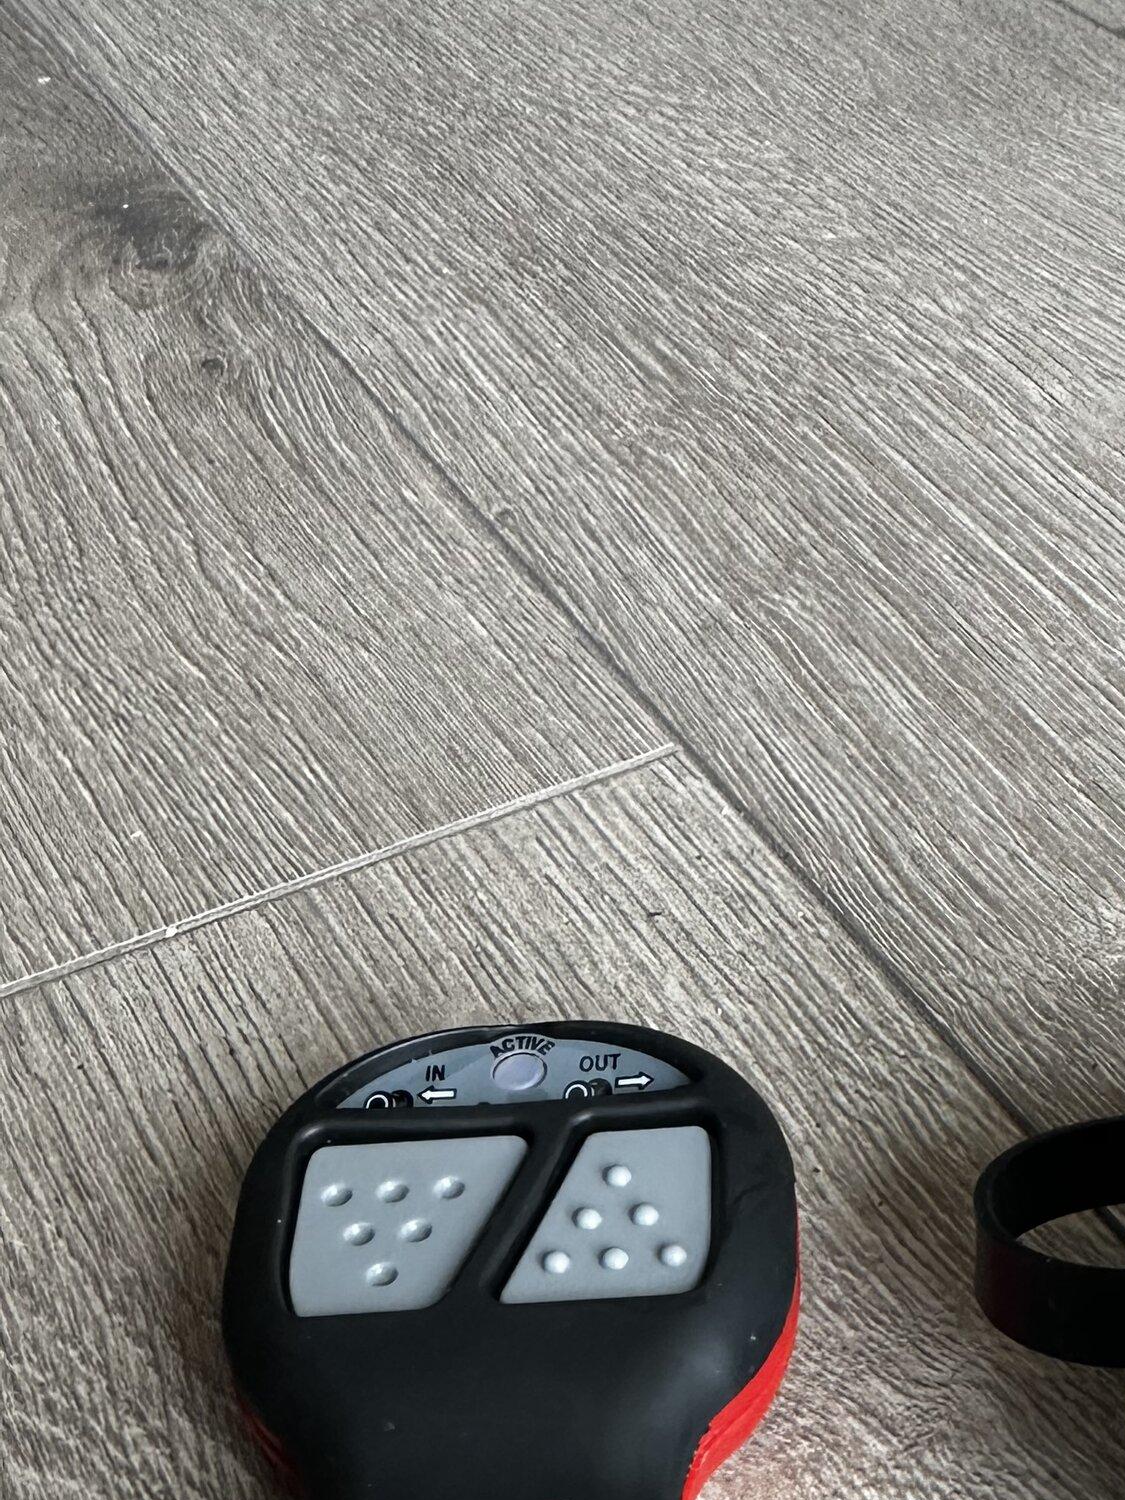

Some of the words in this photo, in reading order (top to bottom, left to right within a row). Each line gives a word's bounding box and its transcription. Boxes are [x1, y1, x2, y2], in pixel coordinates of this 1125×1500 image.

[489, 1036, 556, 1056] ACTIVE
[580, 1054, 620, 1073] OUT
[425, 1065, 446, 1082] IN
